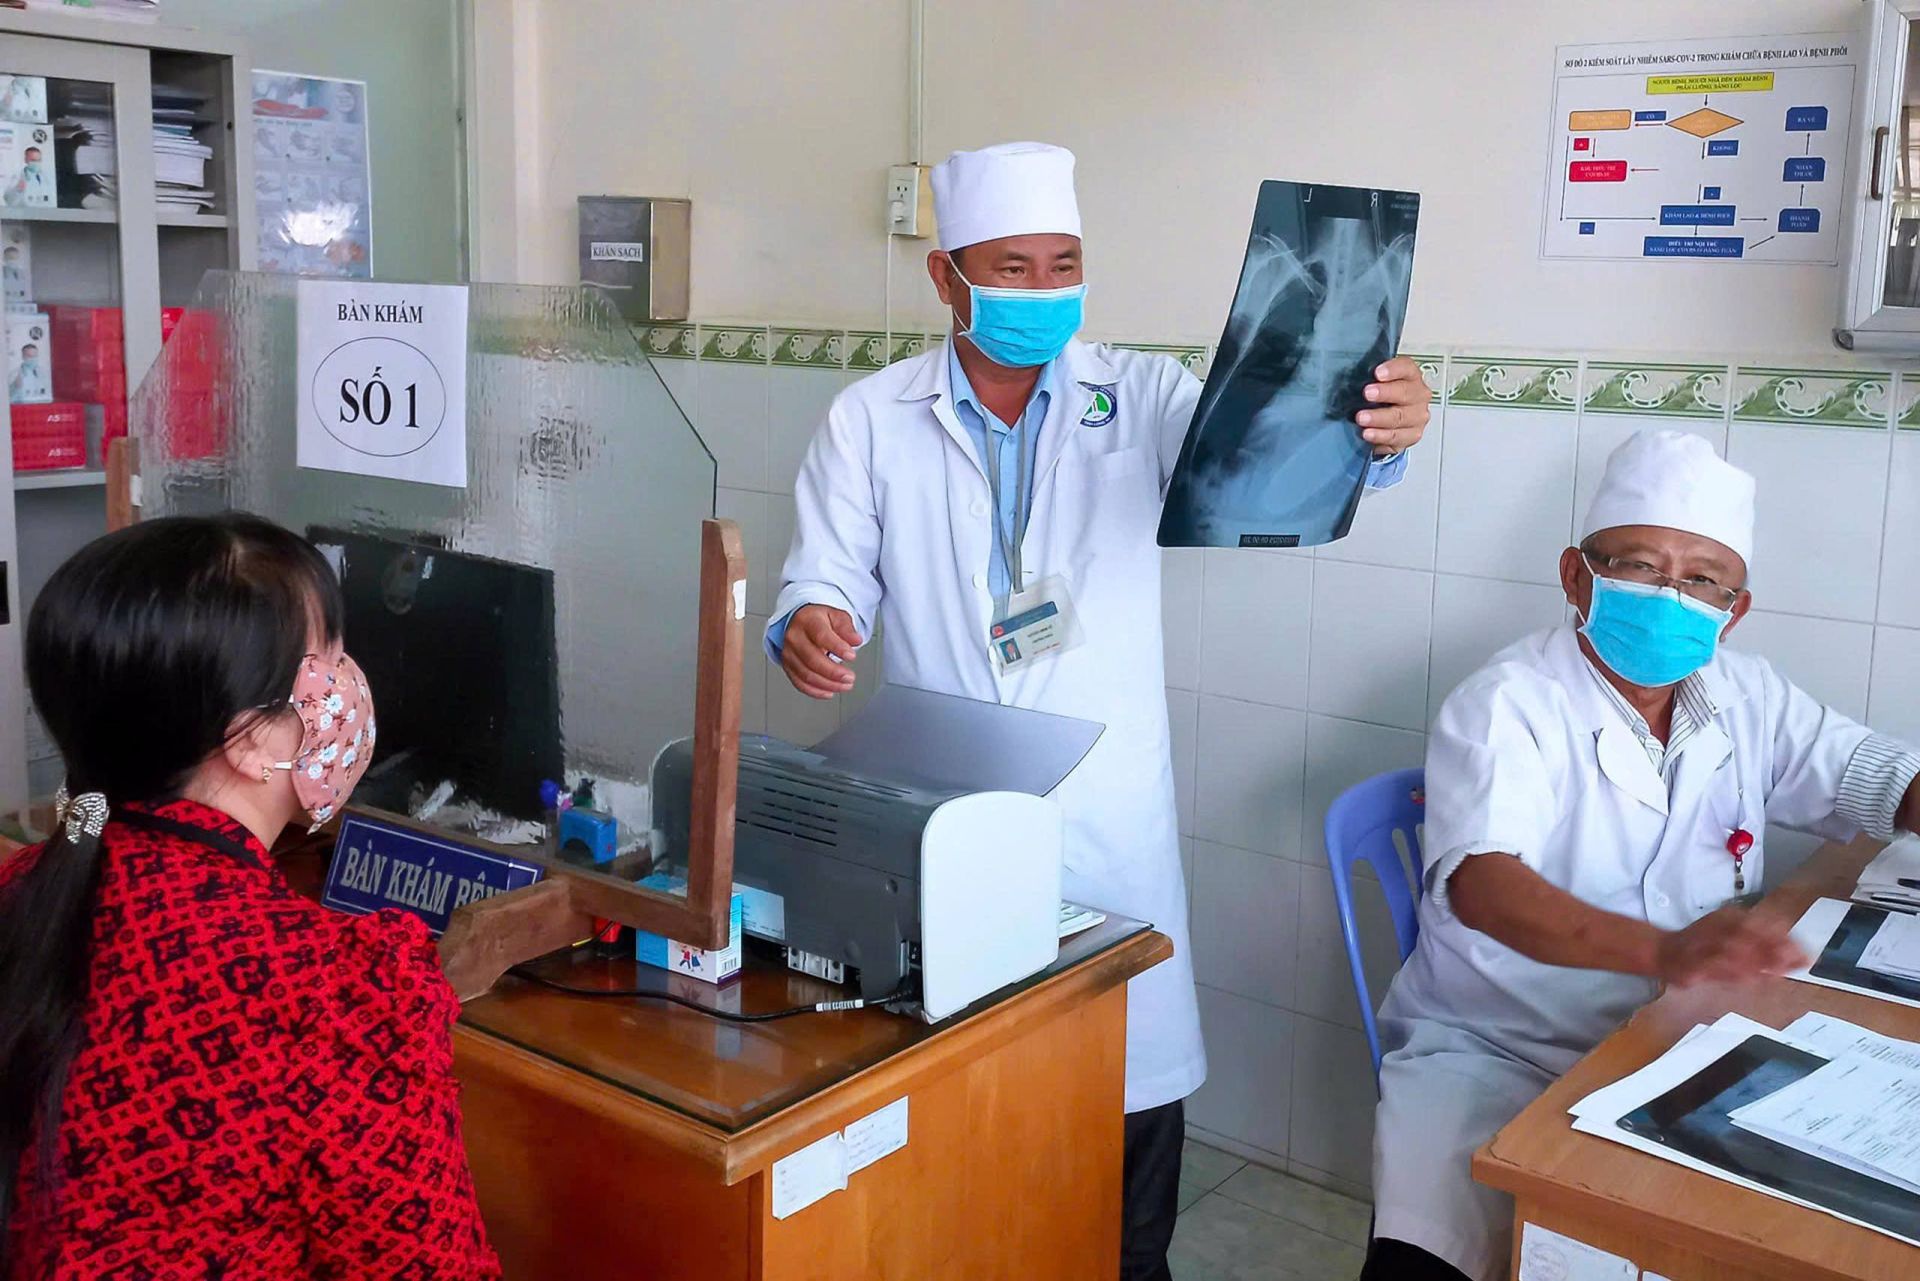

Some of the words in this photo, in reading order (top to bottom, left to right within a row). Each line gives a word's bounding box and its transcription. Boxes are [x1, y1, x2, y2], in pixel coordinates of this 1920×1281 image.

[1697, 53, 1720, 62] TRONG
[1720, 51, 1741, 61] KHÁM
[1763, 49, 1783, 61] BỆNH
[1783, 50, 1798, 59] LAO
[1798, 48, 1808, 58] VÀ
[1810, 47, 1829, 60] BỆNH
[338, 298, 370, 322] BÀN
[374, 299, 424, 324] KHÁM
[339, 366, 392, 425] SỐ
[404, 382, 421, 429] 1
[340, 839, 388, 896] BÀN
[384, 856, 455, 916] KHÁM
